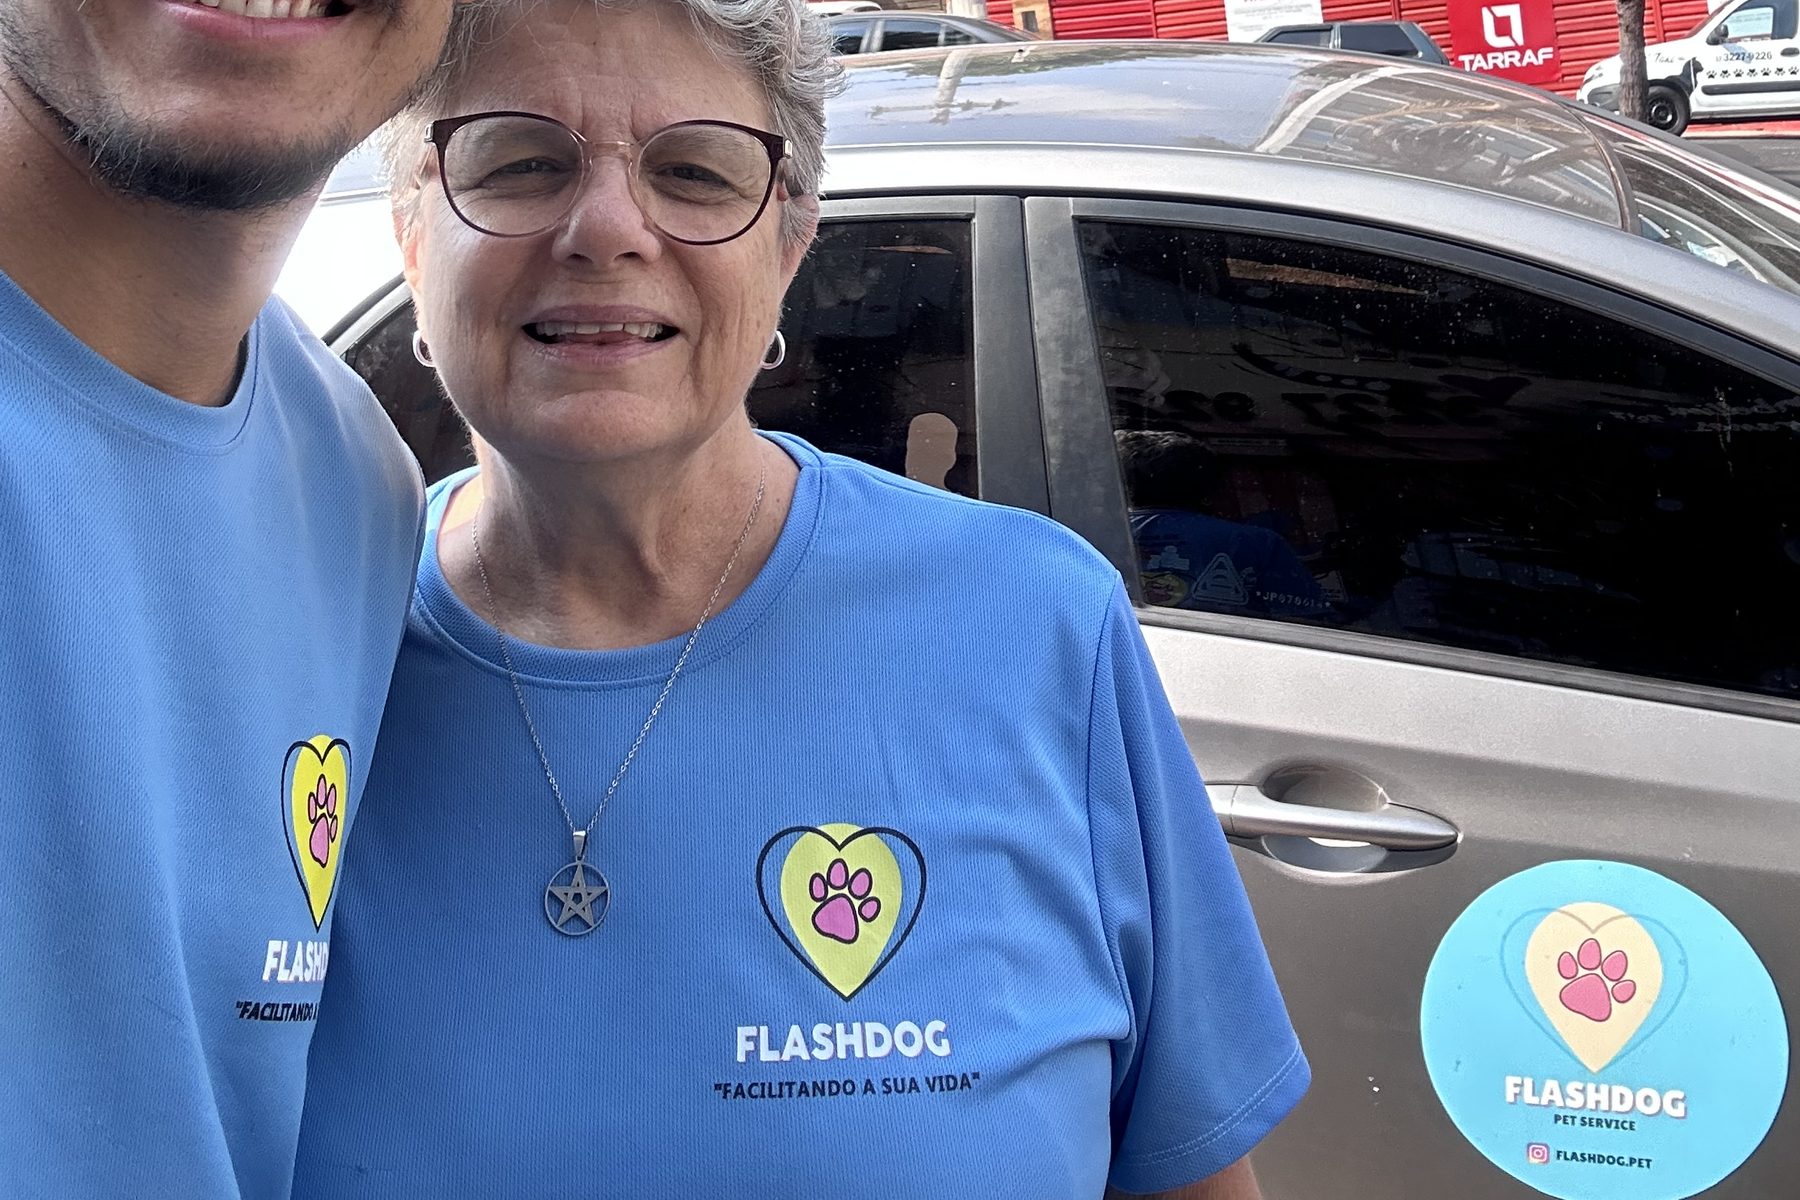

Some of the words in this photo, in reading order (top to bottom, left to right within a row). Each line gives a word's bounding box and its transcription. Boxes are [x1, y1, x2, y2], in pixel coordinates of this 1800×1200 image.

[1458, 47, 1553, 72] TARRAF
[736, 1019, 951, 1063] FLASHDOG
[714, 1079, 856, 1100] "FACILITANDO
[862, 1078, 877, 1096] A
[882, 1077, 921, 1095] SUA
[925, 1071, 980, 1092] VIDA"
[1504, 1075, 1687, 1119] FLASHDOG
[1553, 1113, 1577, 1127] PET
[1580, 1115, 1636, 1131] SERVICE
[1555, 1149, 1653, 1169] FLASHDOG.PET
